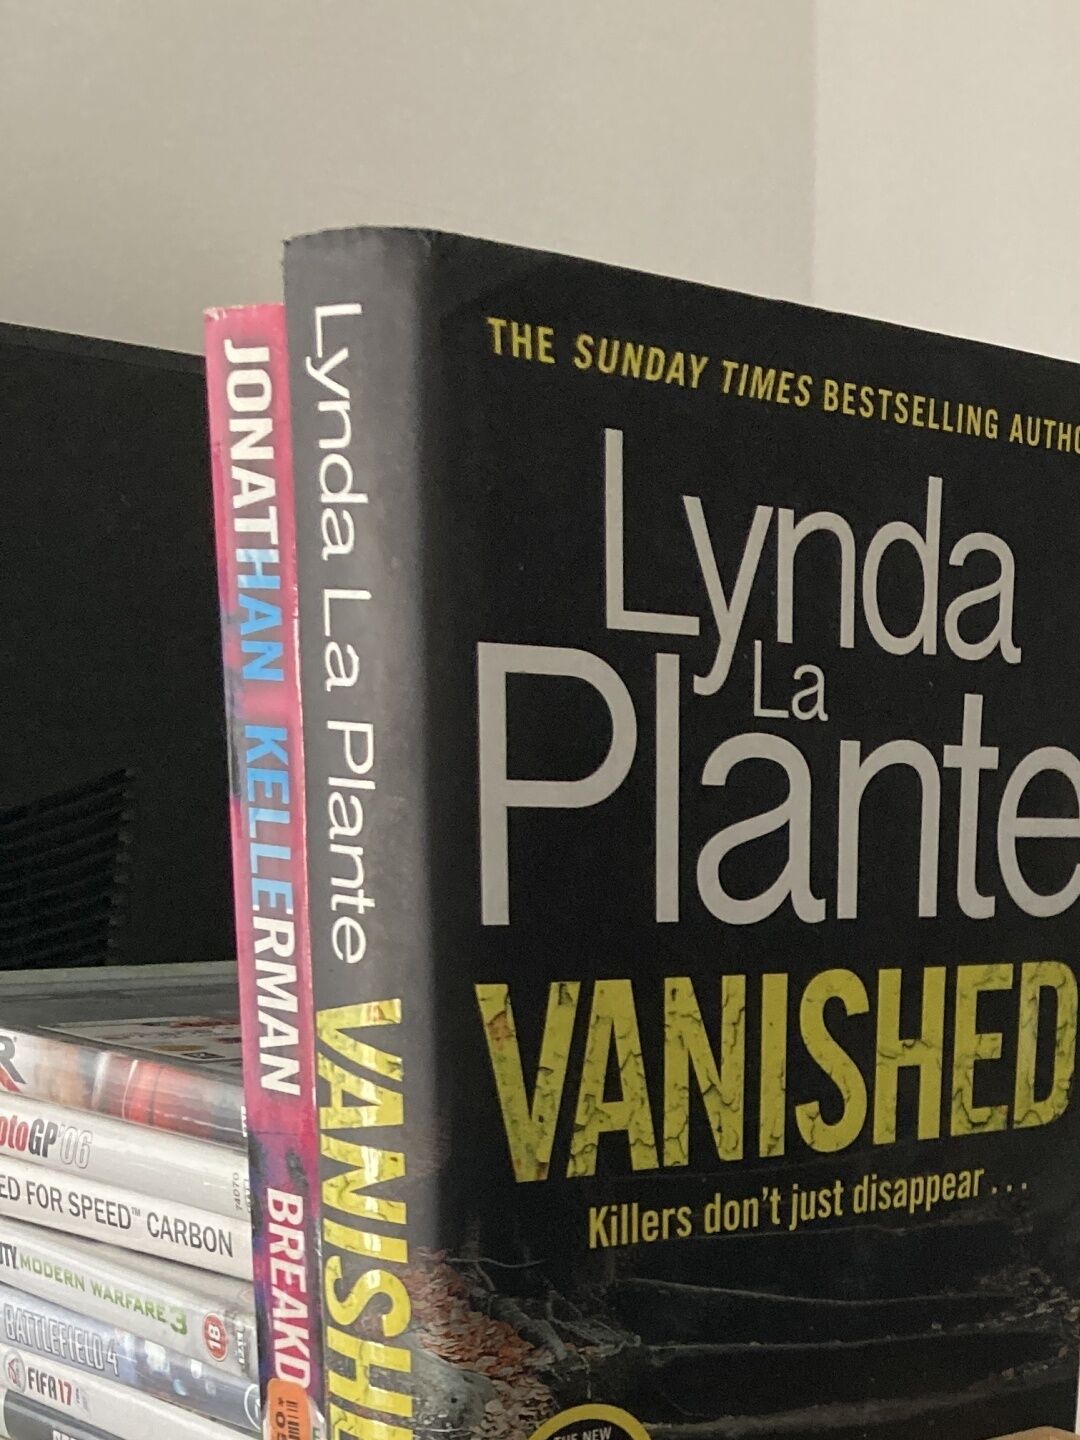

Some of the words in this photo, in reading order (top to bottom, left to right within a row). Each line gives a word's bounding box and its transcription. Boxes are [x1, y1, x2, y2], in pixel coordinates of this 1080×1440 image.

[306, 303, 369, 561] Lynda
[487, 317, 555, 364] THE
[574, 334, 708, 389] SUNDAY
[721, 361, 813, 407] TIMES
[823, 380, 998, 439] BESTSELLING
[224, 339, 284, 681] JONATHAN
[604, 427, 1022, 696] Lynda
[323, 588, 373, 692] La
[754, 641, 829, 721] La
[327, 720, 376, 964] Plante
[244, 725, 301, 1096] KELLERMAN
[475, 961, 1079, 1183] VANISHED
[26, 1181, 63, 1212] FOR
[147, 1211, 234, 1258] CARBON
[588, 1206, 693, 1249] Killers
[704, 1187, 781, 1234] don't
[788, 1183, 844, 1231] just
[4, 1303, 104, 1371] BATTLEFIELD
[106, 1339, 119, 1377] 4
[20, 1253, 85, 1291] MODERN
[90, 1279, 167, 1322] WARFARE
[169, 1306, 188, 1335] 3
[207, 1323, 221, 1351] 18
[266, 1187, 311, 1389] BREAKD
